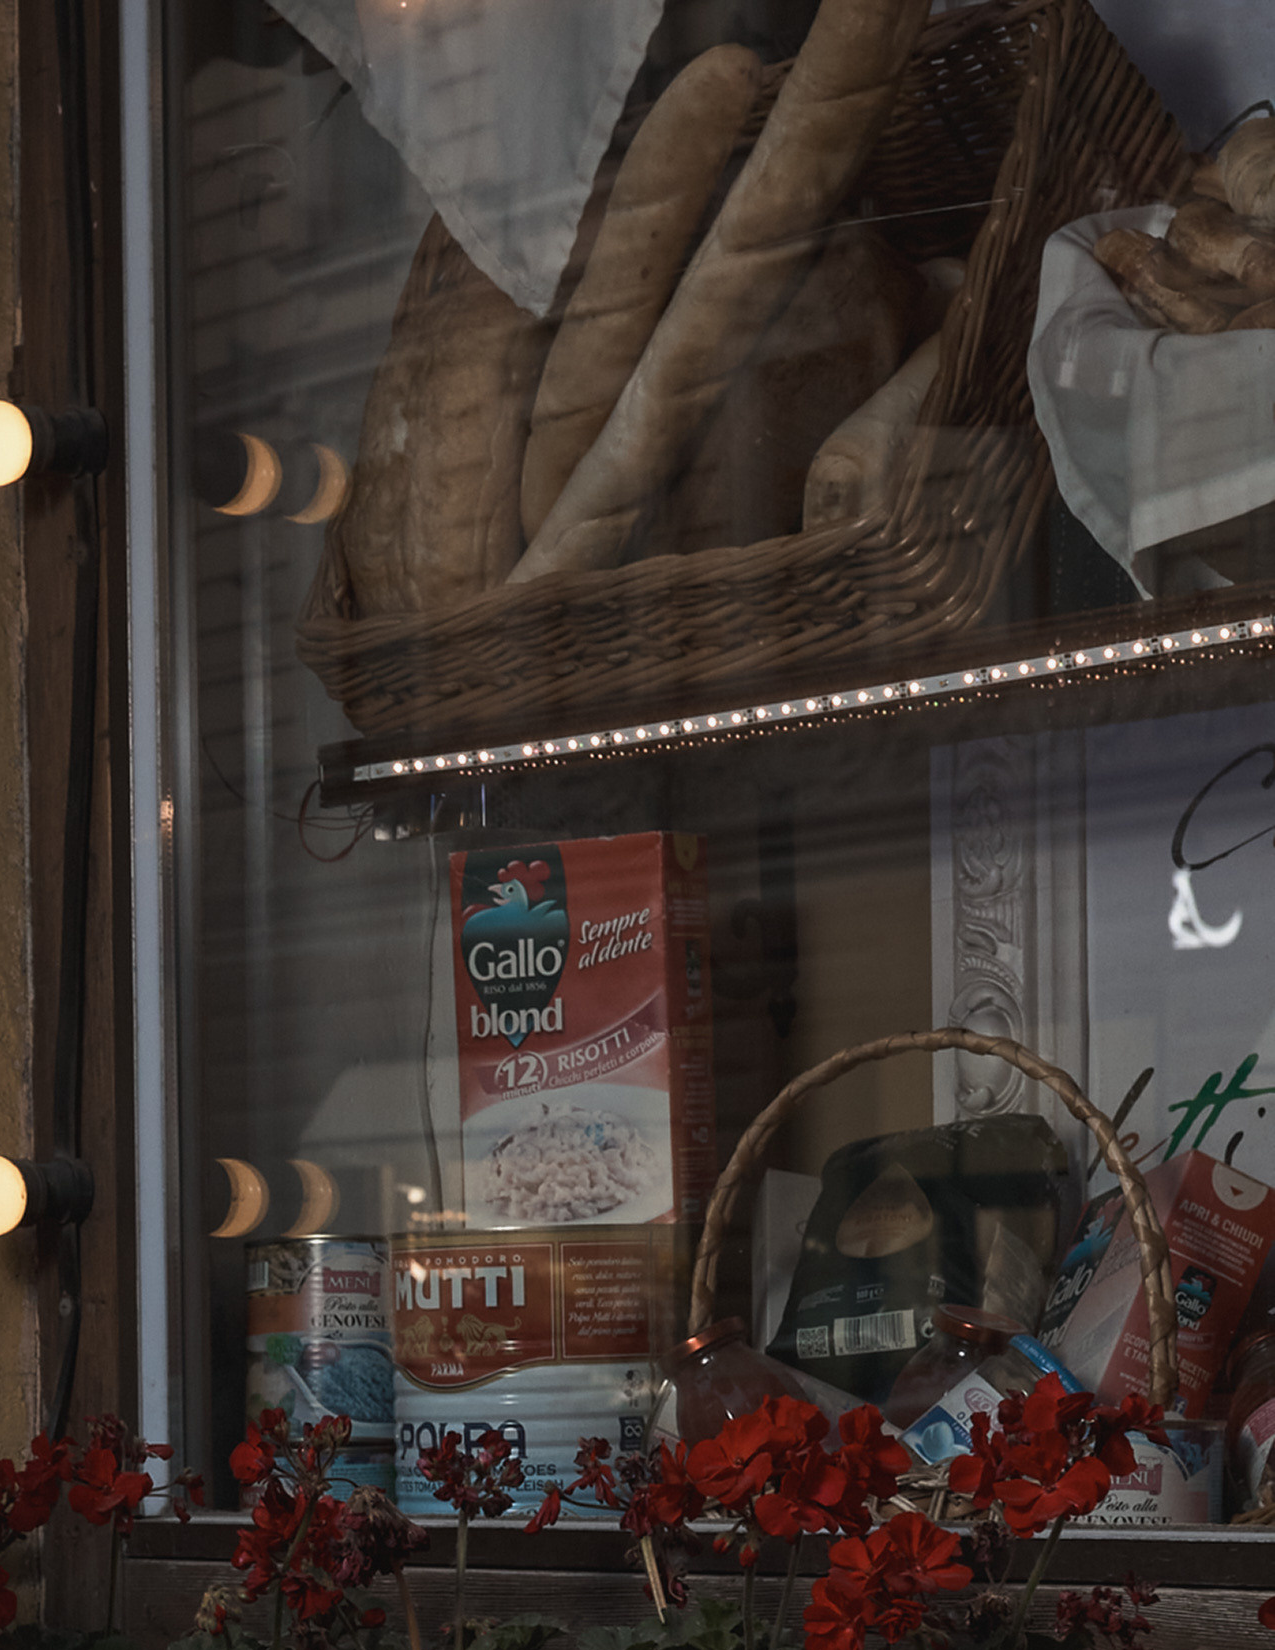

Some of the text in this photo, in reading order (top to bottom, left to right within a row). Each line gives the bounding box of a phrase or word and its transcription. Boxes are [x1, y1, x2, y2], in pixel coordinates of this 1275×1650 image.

[578, 907, 650, 945] Sempre
[468, 938, 563, 982] Gallo
[578, 931, 653, 970] al dente
[483, 982, 547, 995] RISO dal 1856
[470, 997, 563, 1039] blond
[502, 1055, 539, 1088] 12
[557, 1027, 631, 1073] RISOTTI
[583, 1060, 618, 1081] perfetti
[618, 1056, 625, 1064] e
[1179, 1199, 1211, 1222] APRI
[1210, 1213, 1221, 1227] &
[1222, 1218, 1265, 1250] CHIUDI
[395, 1265, 525, 1311] MUTTI
[1045, 1262, 1094, 1312] Gallo
[1175, 1291, 1207, 1316] Gallo
[430, 1362, 465, 1377] PARMA
[1132, 1348, 1151, 1366] TAN
[1095, 1493, 1159, 1512] Pesto alla
